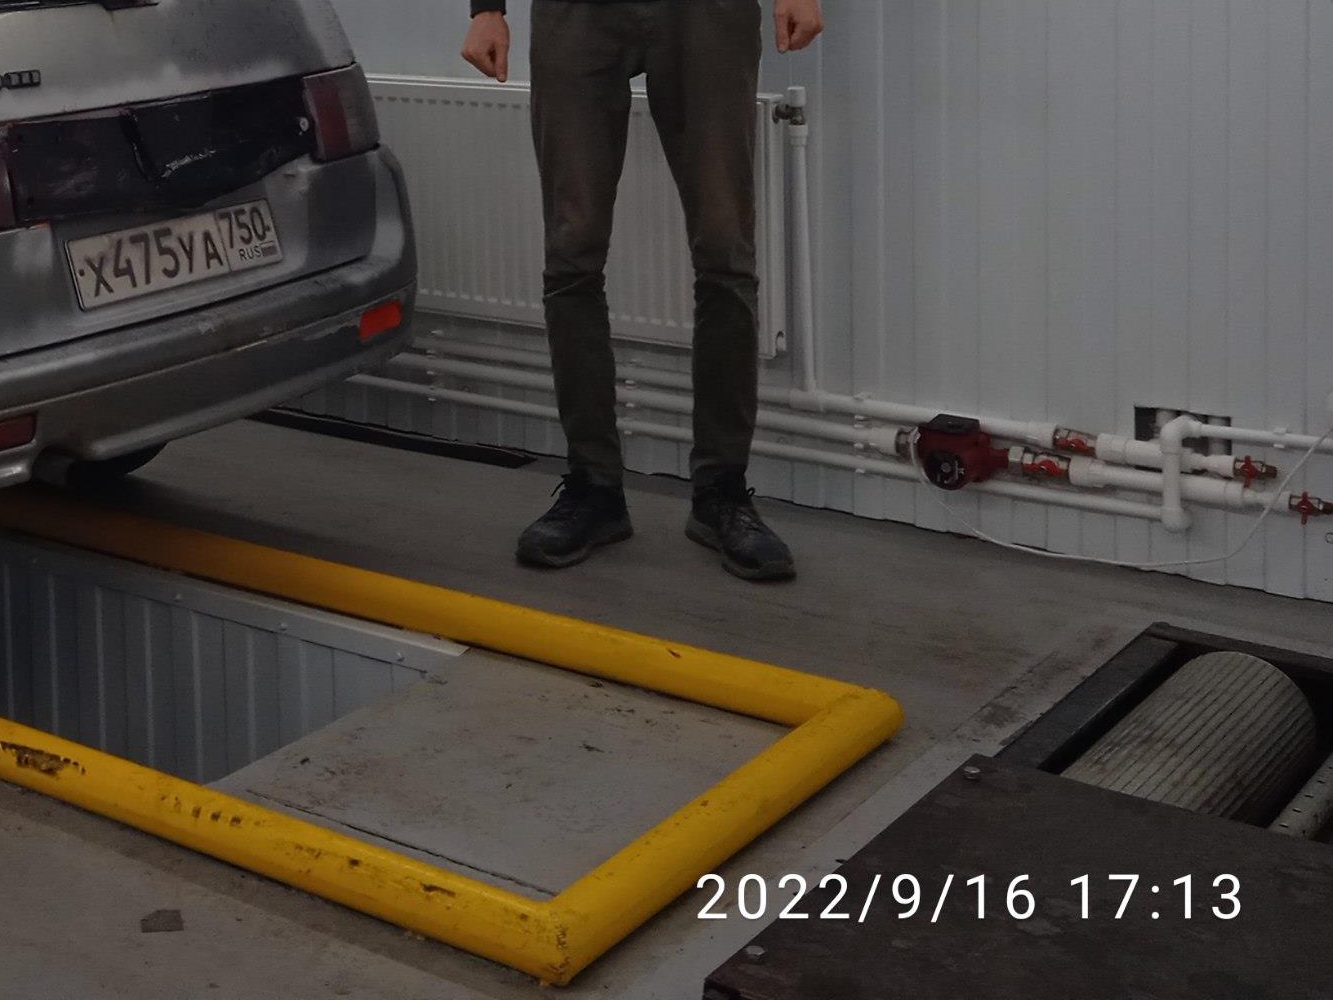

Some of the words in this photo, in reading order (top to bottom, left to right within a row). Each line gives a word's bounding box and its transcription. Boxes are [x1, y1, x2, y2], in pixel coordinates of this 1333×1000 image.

[84, 227, 224, 298] Х475УА
[219, 206, 268, 249] 750
[239, 244, 262, 261] RUS
